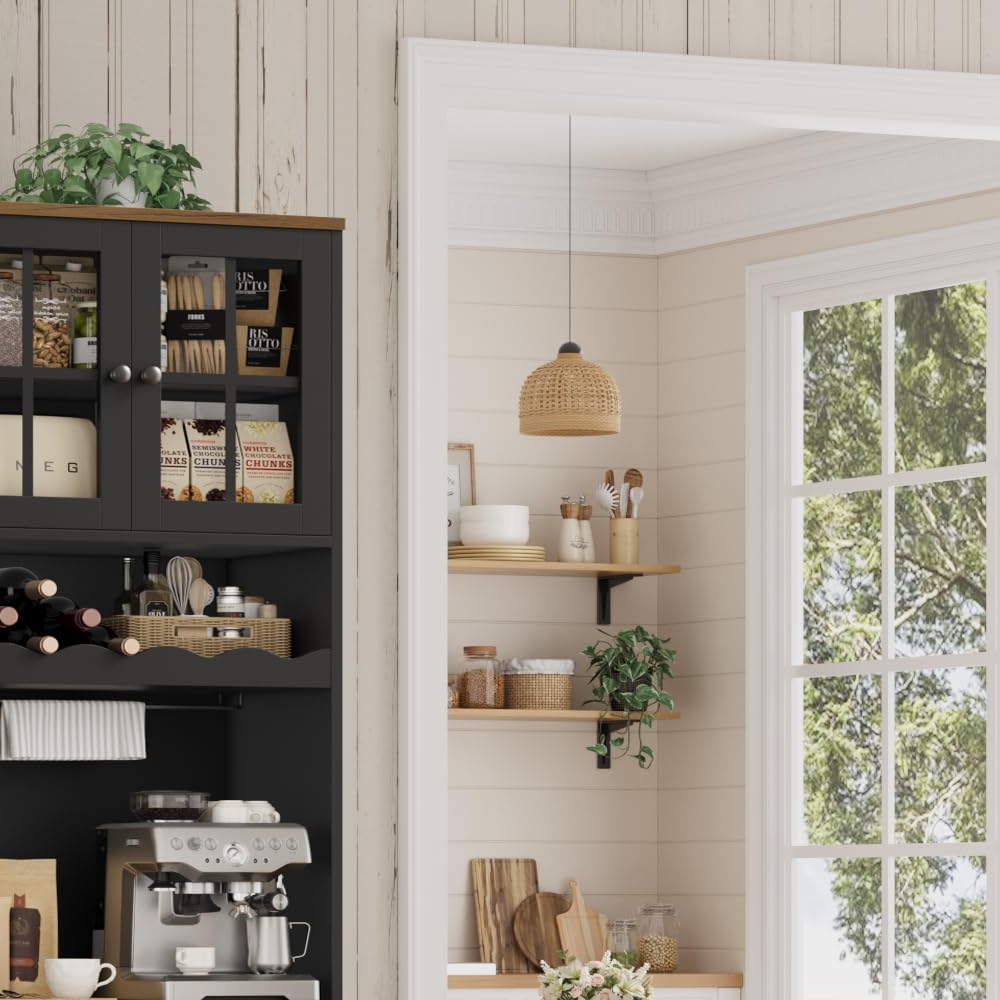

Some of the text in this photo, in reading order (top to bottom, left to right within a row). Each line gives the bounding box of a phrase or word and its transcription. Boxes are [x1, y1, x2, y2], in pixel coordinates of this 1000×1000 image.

[249, 328, 269, 339] RIS
[248, 338, 280, 349] OTTO
[245, 459, 293, 468] CHUNKS
